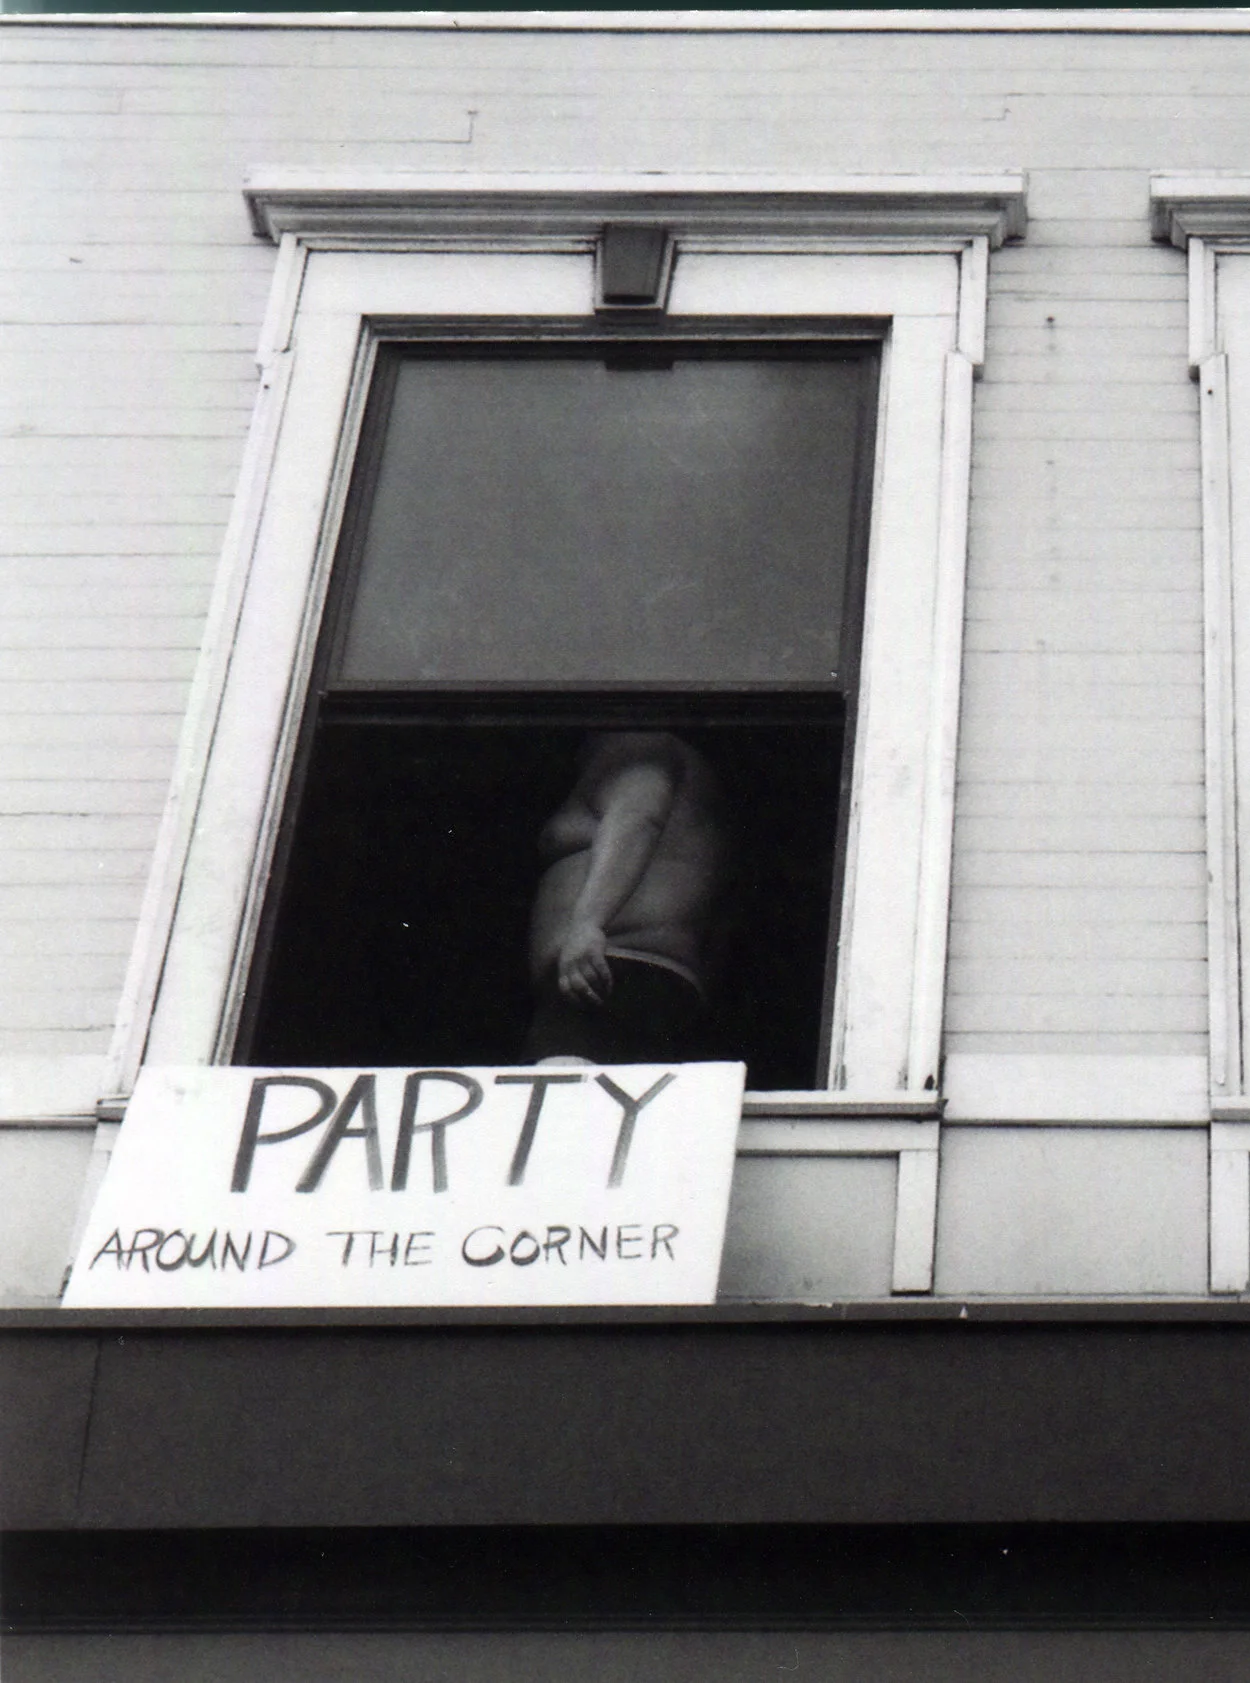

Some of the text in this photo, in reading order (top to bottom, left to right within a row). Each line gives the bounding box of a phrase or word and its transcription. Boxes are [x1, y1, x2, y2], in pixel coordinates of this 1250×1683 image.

[230, 1070, 677, 1193] PARTY
[89, 1223, 680, 1273] AROUND THE CORNER
